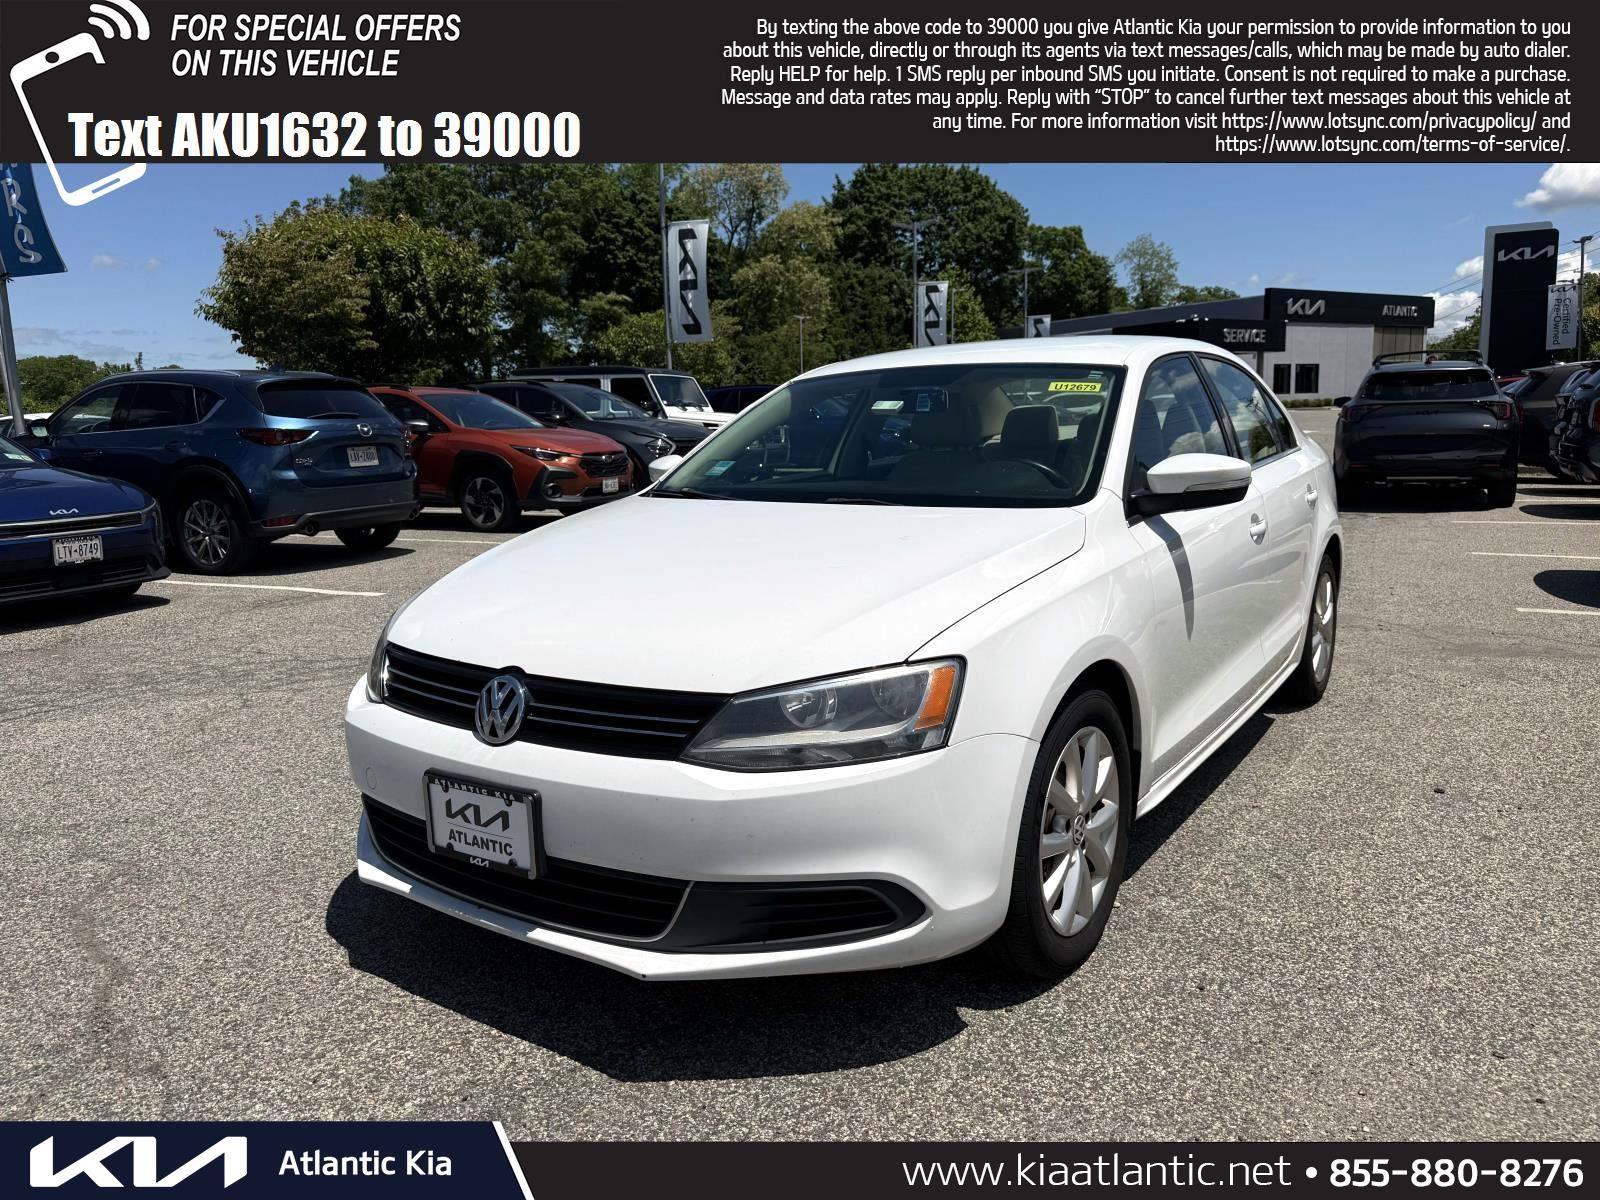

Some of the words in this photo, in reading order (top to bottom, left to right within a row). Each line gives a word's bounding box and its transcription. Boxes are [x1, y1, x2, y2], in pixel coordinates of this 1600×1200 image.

[1498, 245, 1555, 261] KIA
[1286, 297, 1325, 315] KIA
[1382, 304, 1418, 317] ATLANTIC
[1553, 298, 1562, 345] Pre-Owned
[1562, 297, 1571, 335] Certified
[1223, 328, 1267, 343] SERVICE
[1054, 383, 1097, 391] U12679
[434, 778, 488, 796] ATLANTIC
[494, 791, 516, 801] KIA
[445, 798, 510, 832] KIA
[448, 828, 513, 857] ATLANTIC
[469, 856, 490, 868] KIA
